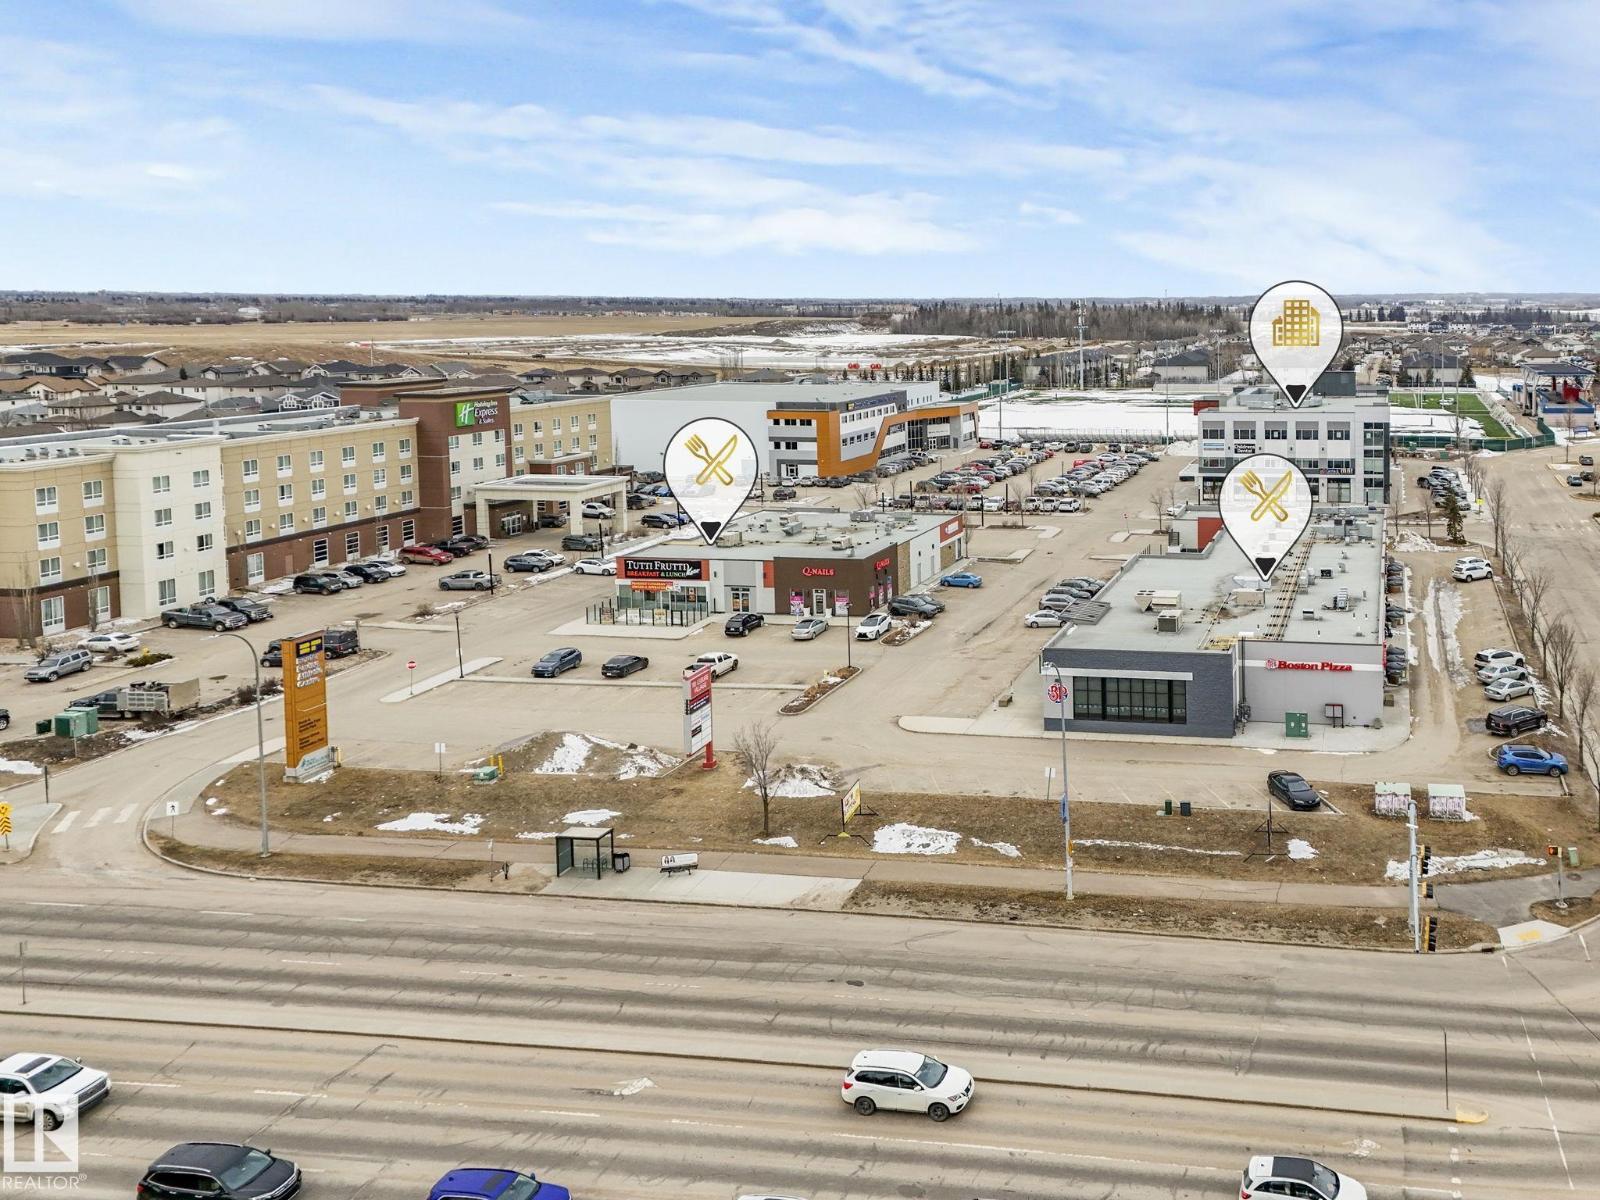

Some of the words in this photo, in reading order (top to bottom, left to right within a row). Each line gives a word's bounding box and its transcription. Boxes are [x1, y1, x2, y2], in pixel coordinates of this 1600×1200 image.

[474, 407, 498, 418] Express
[626, 560, 653, 570] TUTTI
[654, 560, 688, 571] FRUTTI
[802, 566, 835, 576] Q-NAILS
[1277, 660, 1319, 671] Boston
[1320, 662, 1353, 672] Pizza
